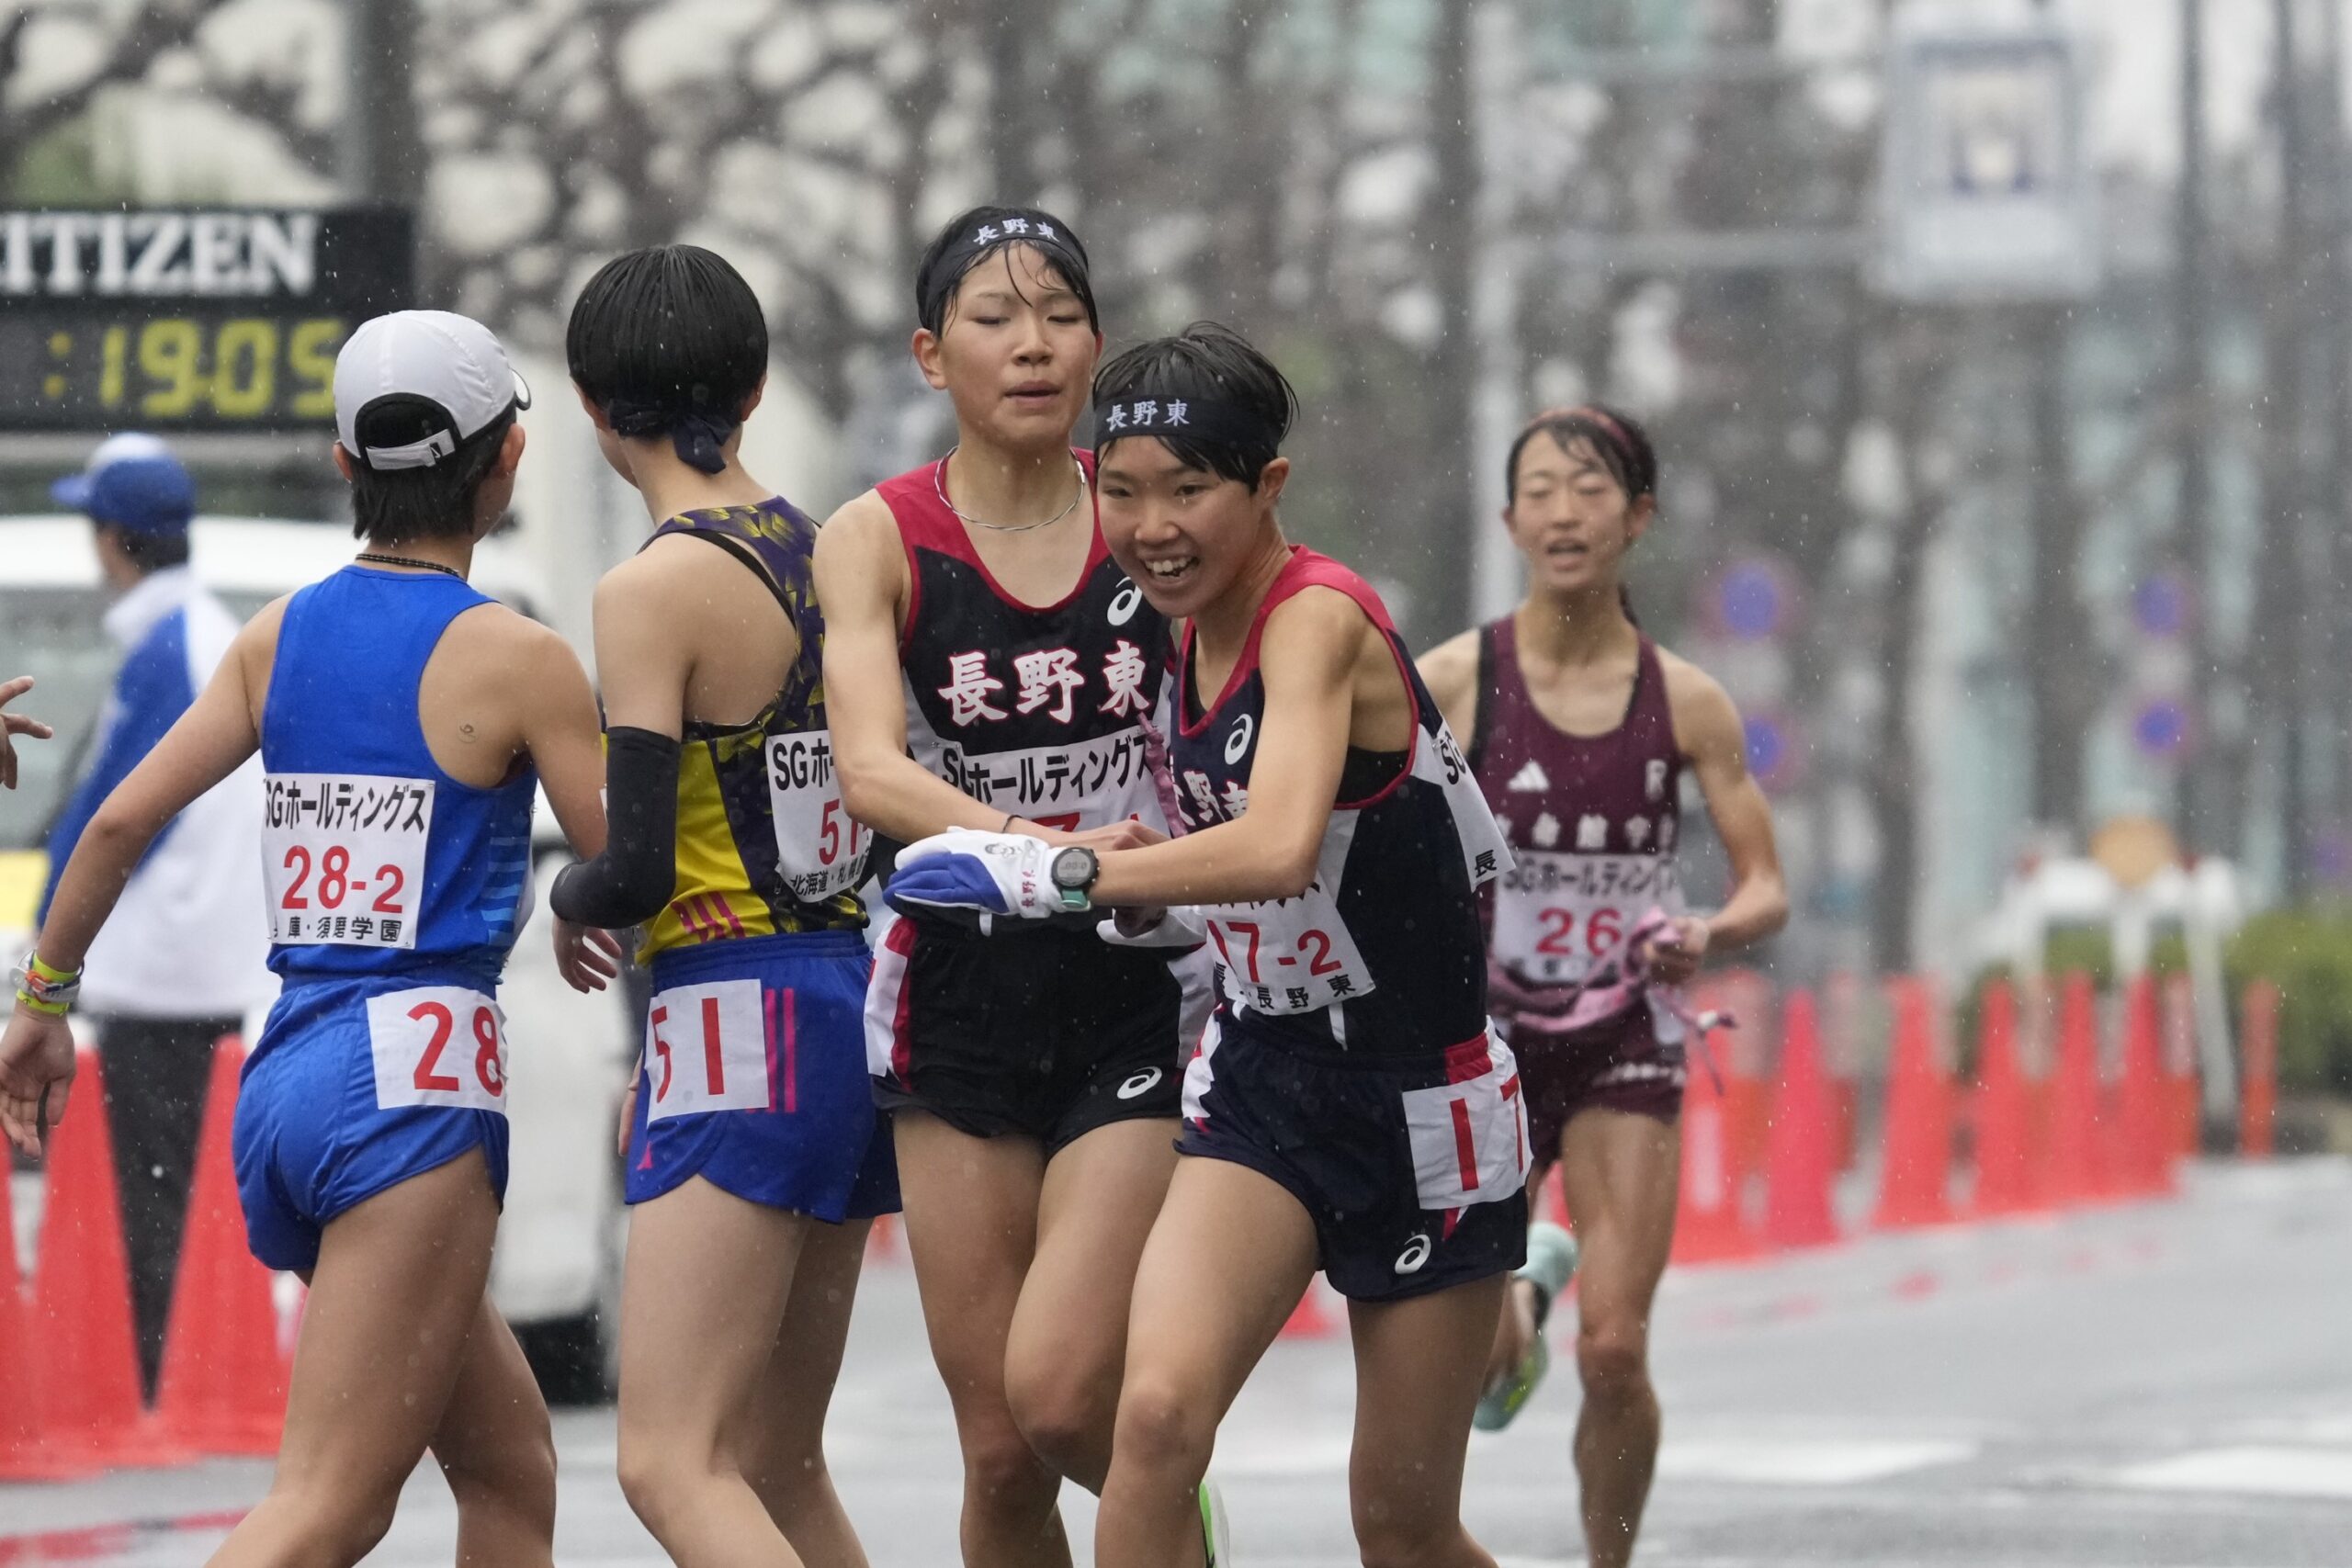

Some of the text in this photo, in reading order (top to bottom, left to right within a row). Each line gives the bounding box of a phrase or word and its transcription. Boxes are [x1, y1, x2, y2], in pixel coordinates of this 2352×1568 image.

[0, 211, 318, 296] ITIZEN
[1105, 398, 1191, 433] 長野東
[938, 640, 1150, 727] 長野東
[772, 738, 833, 791] SGホ
[281, 845, 404, 914] 28-2
[1475, 849, 1497, 878] 長
[274, 916, 402, 942] 庫・須磨学園
[1535, 907, 1622, 957] 26
[405, 1000, 503, 1098] 28
[650, 998, 726, 1104] 51
[1449, 1072, 1524, 1192] 17
